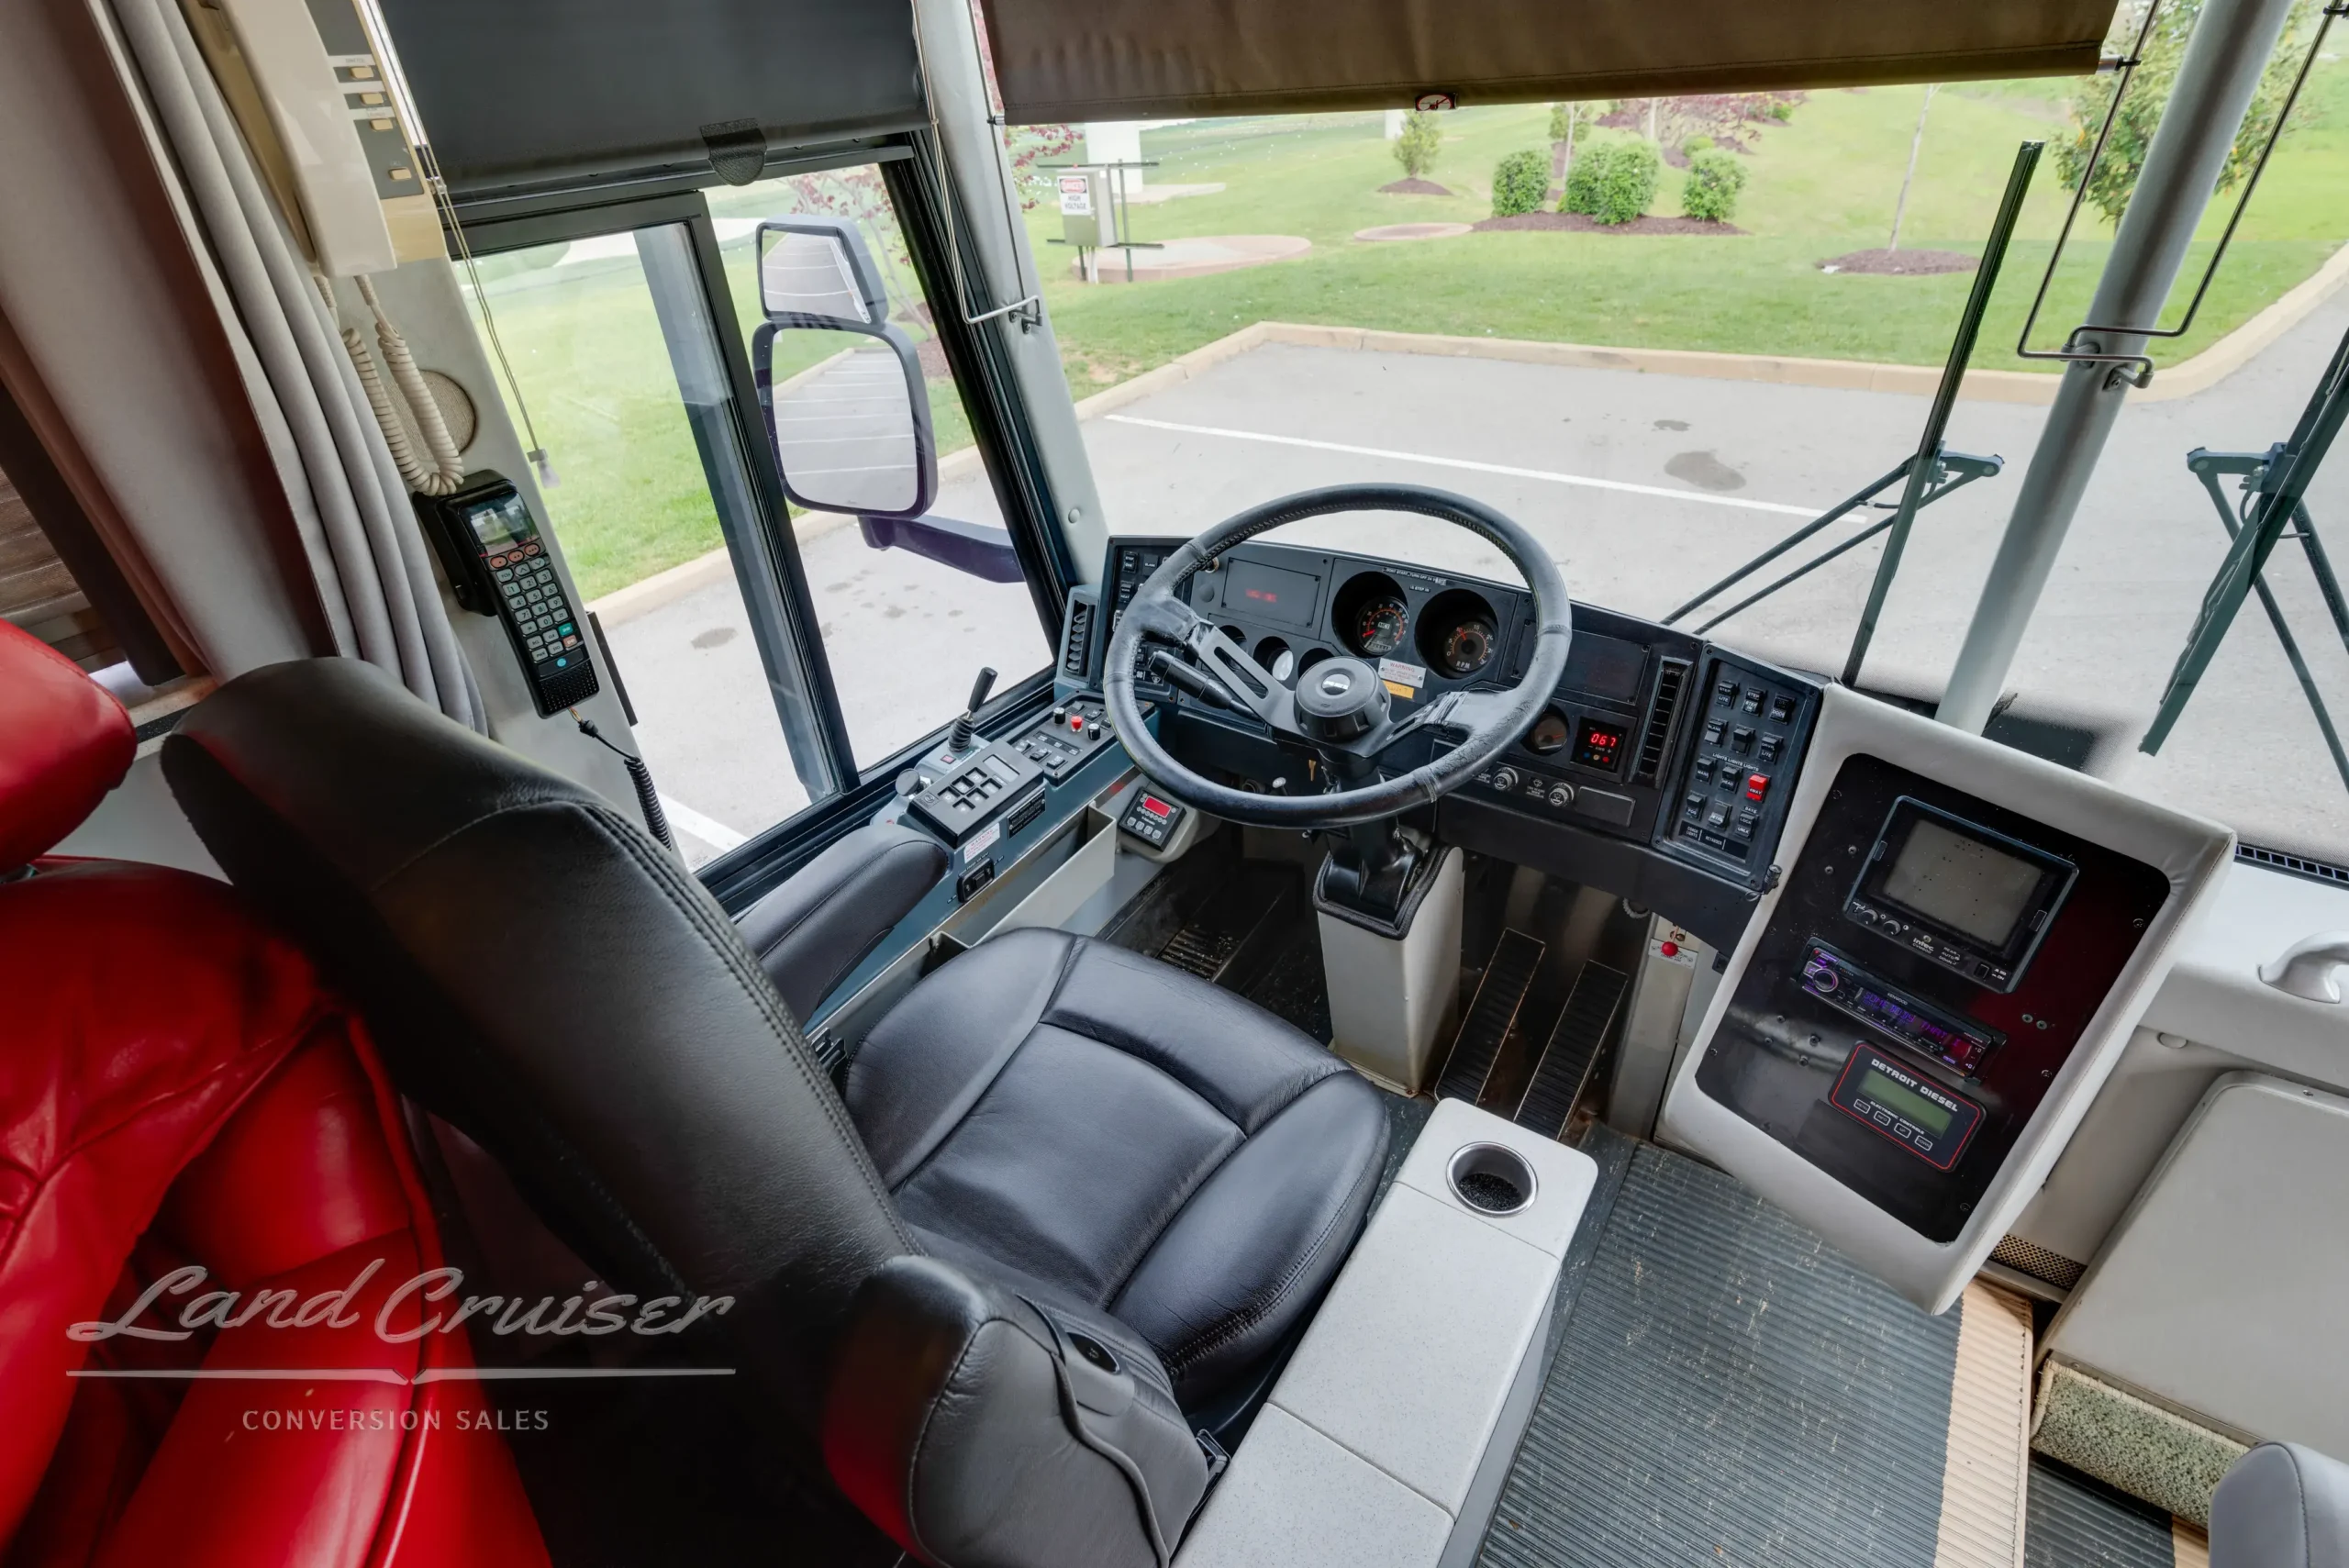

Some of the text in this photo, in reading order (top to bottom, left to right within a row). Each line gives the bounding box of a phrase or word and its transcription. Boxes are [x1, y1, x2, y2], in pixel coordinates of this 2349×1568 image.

[1389, 662, 1415, 673] WARNING
[1456, 661, 1471, 669] RPM
[1590, 733, 1617, 747] 067
[1712, 752, 1759, 772] LIGHTS LIGHTS LIGHTS
[1941, 951, 1954, 960] AUTO
[1943, 947, 1957, 955] REAR
[1887, 993, 1908, 1005] KENWOOD
[1871, 1058, 1958, 1112] DETROIT DIESEL
[1870, 1101, 1925, 1135] ELECTRONIC CONTROLS
